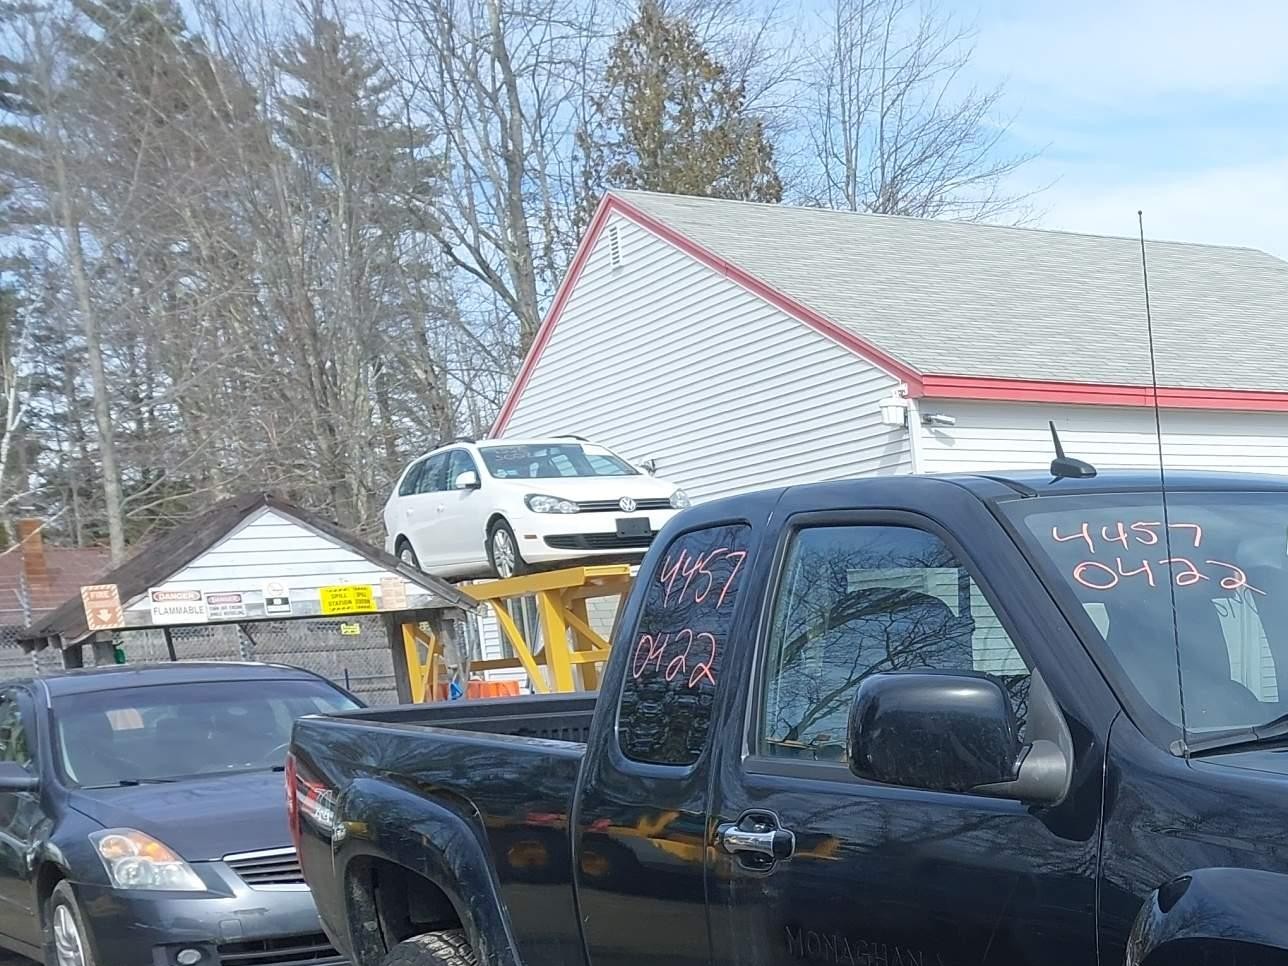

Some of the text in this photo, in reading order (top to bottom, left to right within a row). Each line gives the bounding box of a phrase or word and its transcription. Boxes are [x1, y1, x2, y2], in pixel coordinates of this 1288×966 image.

[1052, 521, 1202, 553] 4457
[660, 547, 747, 608] 4457
[1073, 557, 1267, 595] 0422
[153, 604, 205, 617] FLAMMABLE
[159, 590, 195, 600] DANGER
[632, 628, 717, 689] 0422
